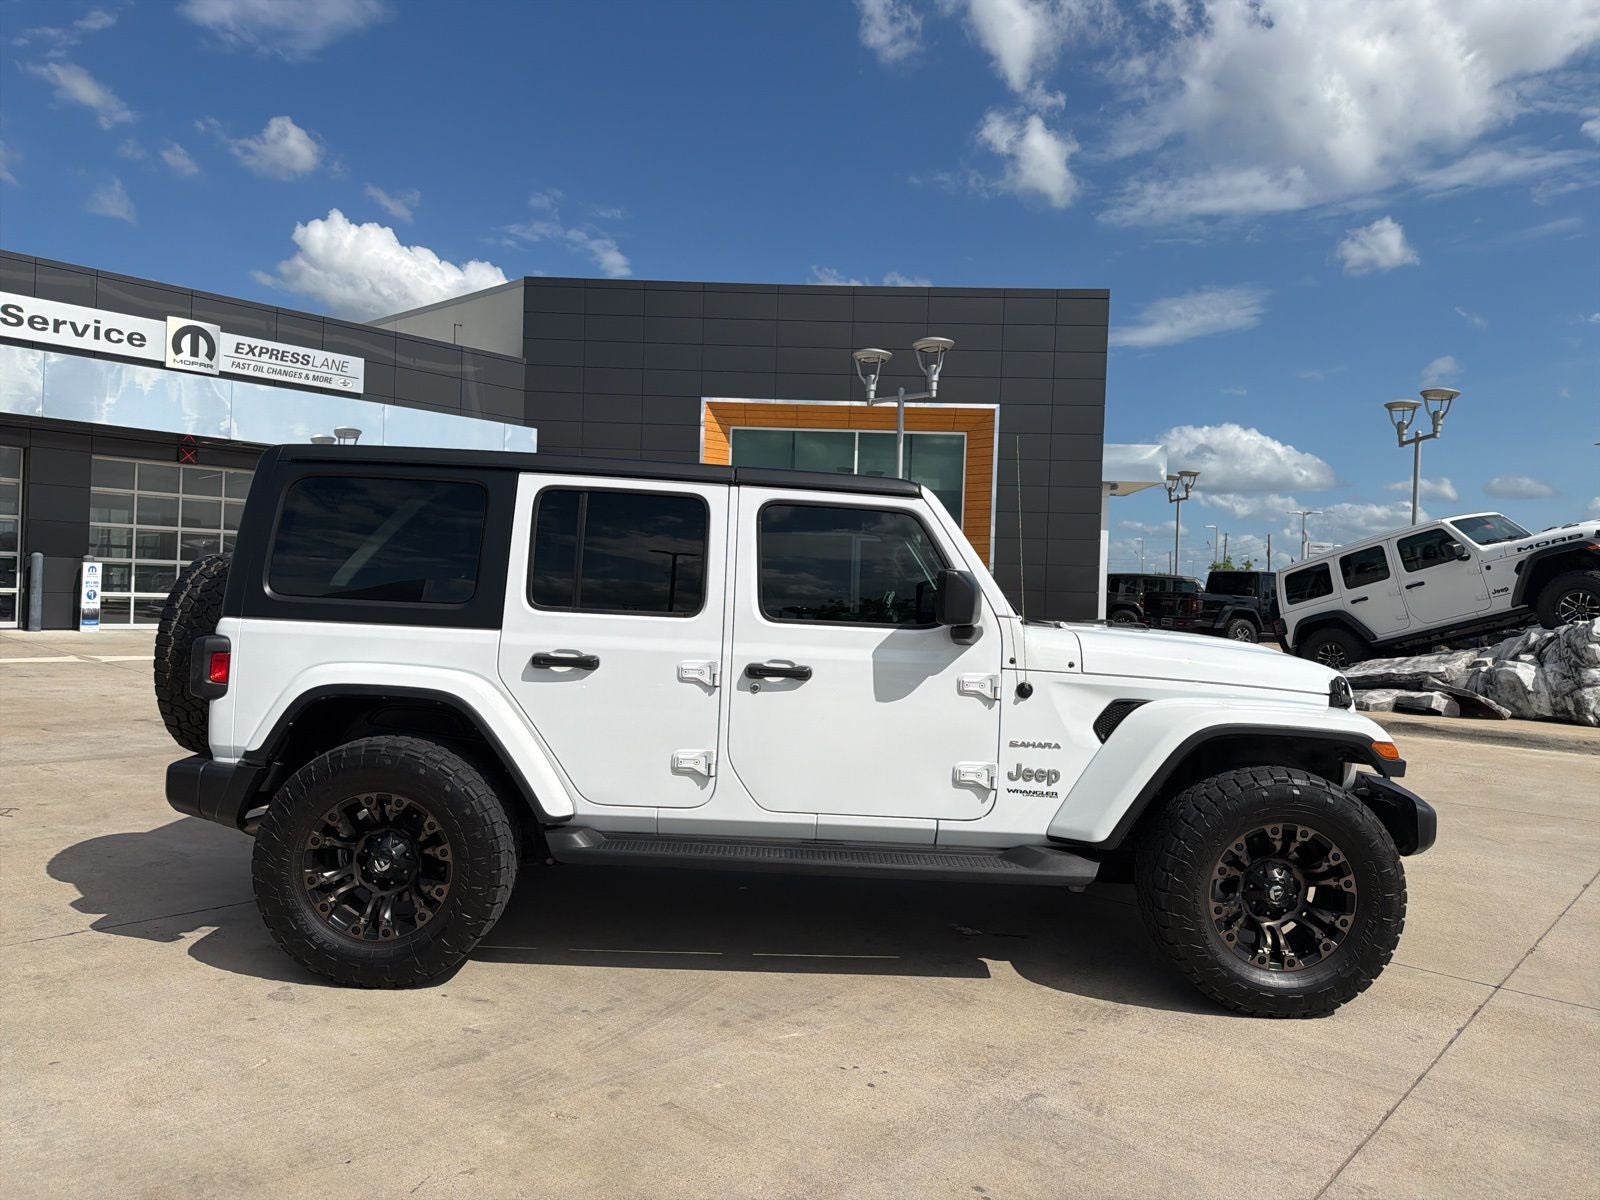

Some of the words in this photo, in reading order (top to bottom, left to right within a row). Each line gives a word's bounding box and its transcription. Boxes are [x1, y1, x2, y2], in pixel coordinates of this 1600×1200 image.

[0, 303, 147, 348] Service
[173, 358, 214, 370] MOPAR
[231, 361, 251, 371] FAST
[252, 364, 265, 373] OIL
[266, 366, 303, 379] CHANGES
[304, 373, 310, 381] &
[312, 374, 333, 384] MORE
[1517, 533, 1584, 552] MOAB
[1491, 586, 1509, 595] Jeep
[1008, 740, 1061, 750] SAHARA
[1007, 762, 1061, 787] Jeep
[1006, 788, 1058, 797] WRANGLER
